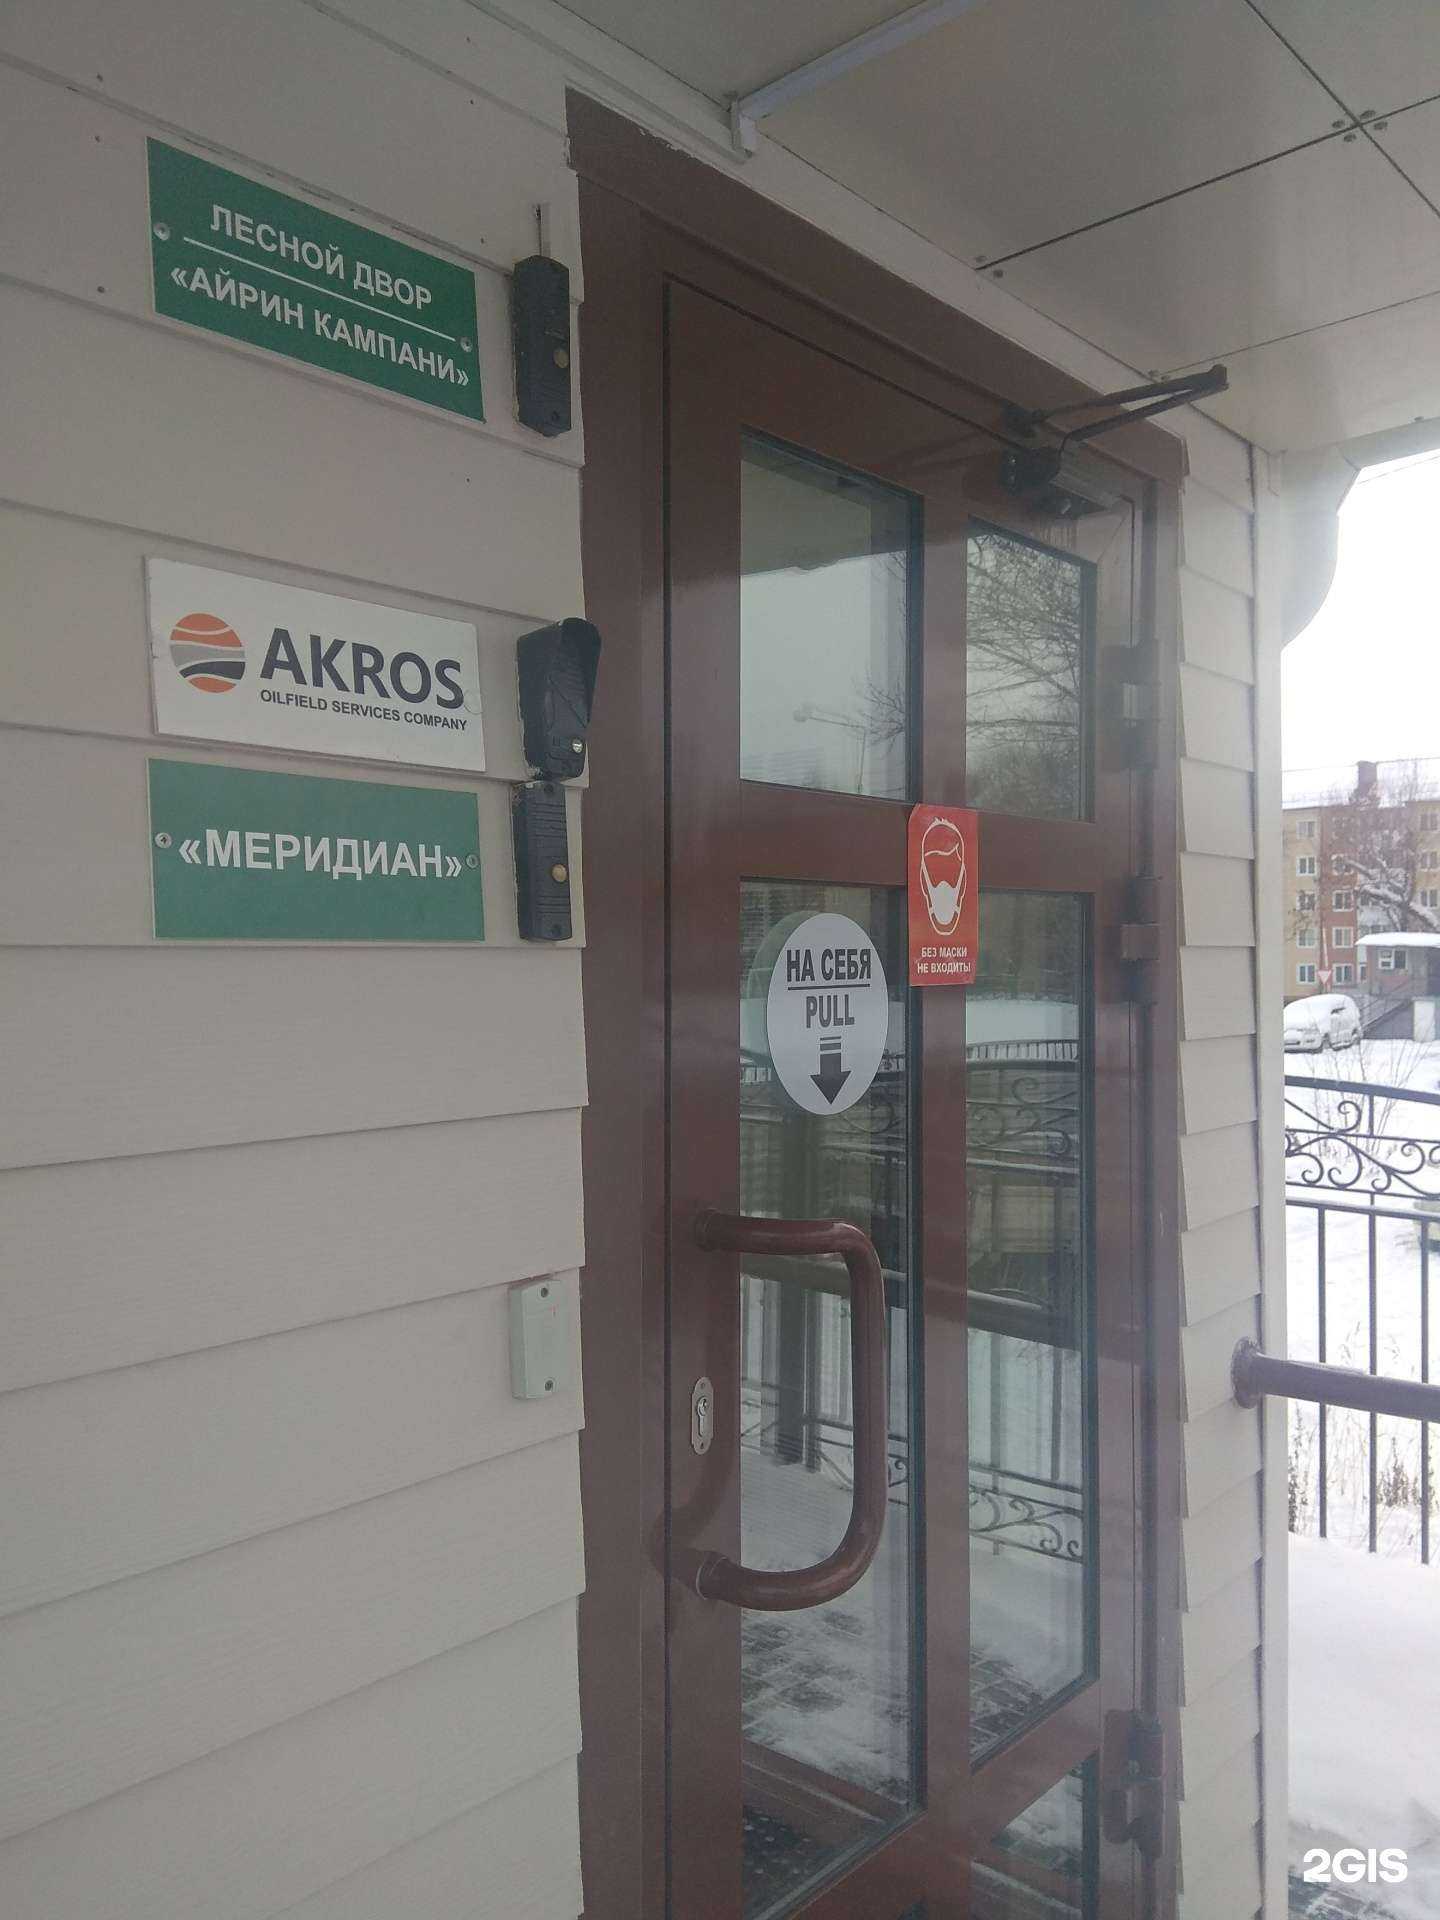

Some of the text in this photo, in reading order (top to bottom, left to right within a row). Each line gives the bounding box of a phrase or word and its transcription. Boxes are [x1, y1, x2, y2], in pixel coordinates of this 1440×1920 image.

[210, 204, 432, 309] ЛЕСНОЙ ДВОР
[171, 266, 469, 387] «АЙРИН КАМПАНИ»
[260, 627, 465, 710] AKROS
[260, 688, 467, 731] OILFIELD SERVICES COMPANY
[178, 829, 462, 881] «МЕРИДИАН»
[787, 948, 871, 982] НА СЕБЯ
[917, 962, 929, 974] НЕ
[921, 947, 967, 958] БЕЗ МАСКИ
[806, 994, 855, 1029] PULL
